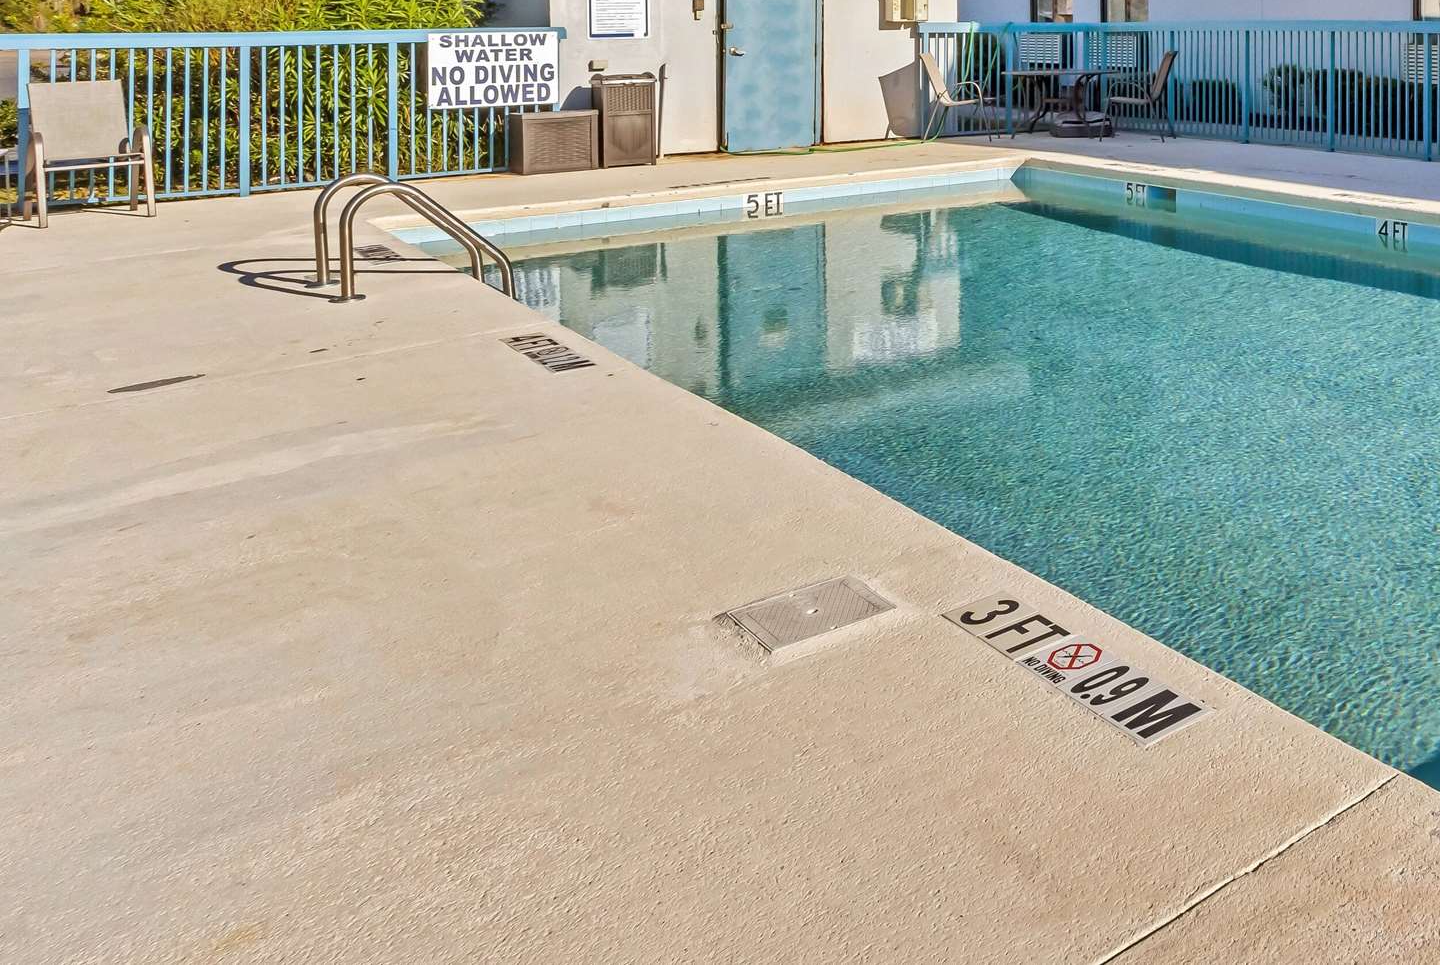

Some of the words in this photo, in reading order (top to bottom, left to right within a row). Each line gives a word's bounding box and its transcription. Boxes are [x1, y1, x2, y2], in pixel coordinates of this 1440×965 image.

[439, 33, 547, 48] SHALLOW
[455, 48, 533, 63] WATER
[431, 66, 465, 86] NO
[475, 63, 555, 85] DIVING
[436, 83, 551, 107] ALLOWED
[1378, 220, 1388, 236] 4
[1392, 221, 1408, 240] FT
[960, 599, 1020, 625] 3
[985, 613, 1071, 653] FT
[1022, 656, 1042, 672] NO
[1033, 664, 1066, 685] DIVING
[1070, 665, 1150, 706] 0.9
[1111, 689, 1203, 739] M
